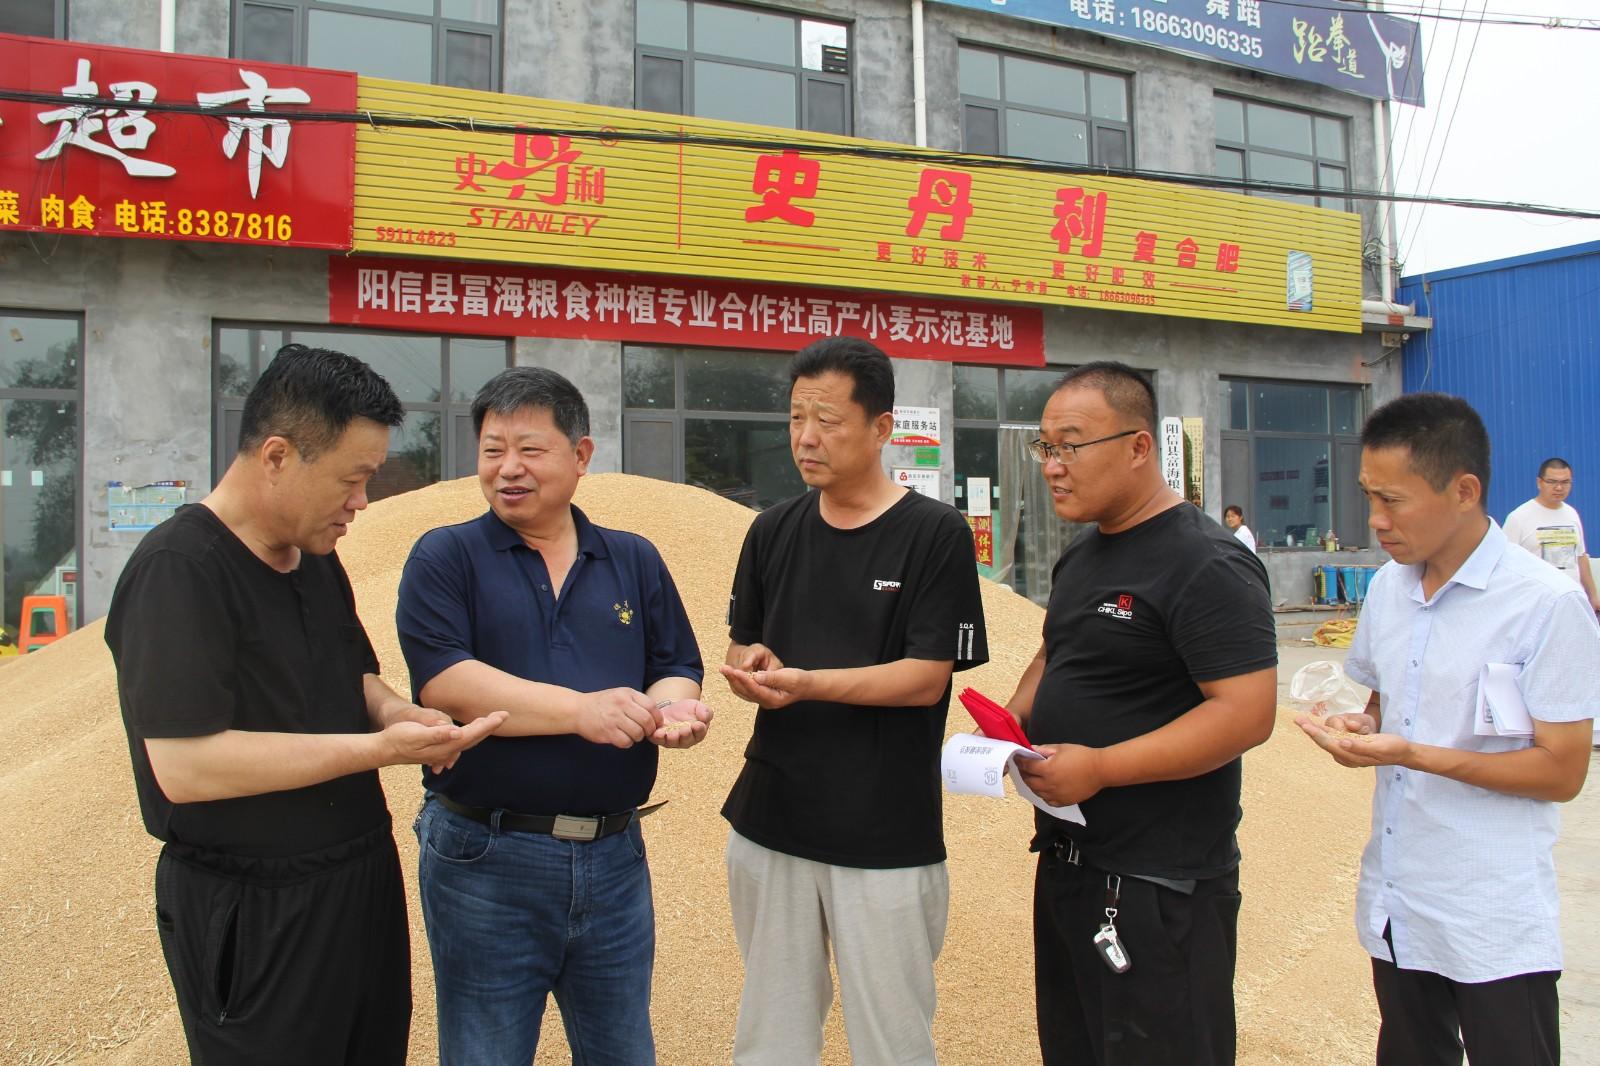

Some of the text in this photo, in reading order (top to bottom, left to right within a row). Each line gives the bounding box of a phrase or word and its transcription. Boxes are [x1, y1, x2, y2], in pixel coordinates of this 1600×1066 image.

[1293, 13, 1365, 79] 跆拳道
[0, 58, 312, 200] 超市
[41, 193, 96, 230] 肉食
[115, 199, 292, 241] 电话:8387816
[466, 207, 600, 236] STANLEY
[745, 150, 1240, 273] 史丹利 复合肥
[875, 241, 988, 271] 更好技术
[357, 269, 1015, 350] 阳信县富海粮食种植专业合作社高产小麦示范基地
[1166, 423, 1181, 494] 阳信县富海粮
